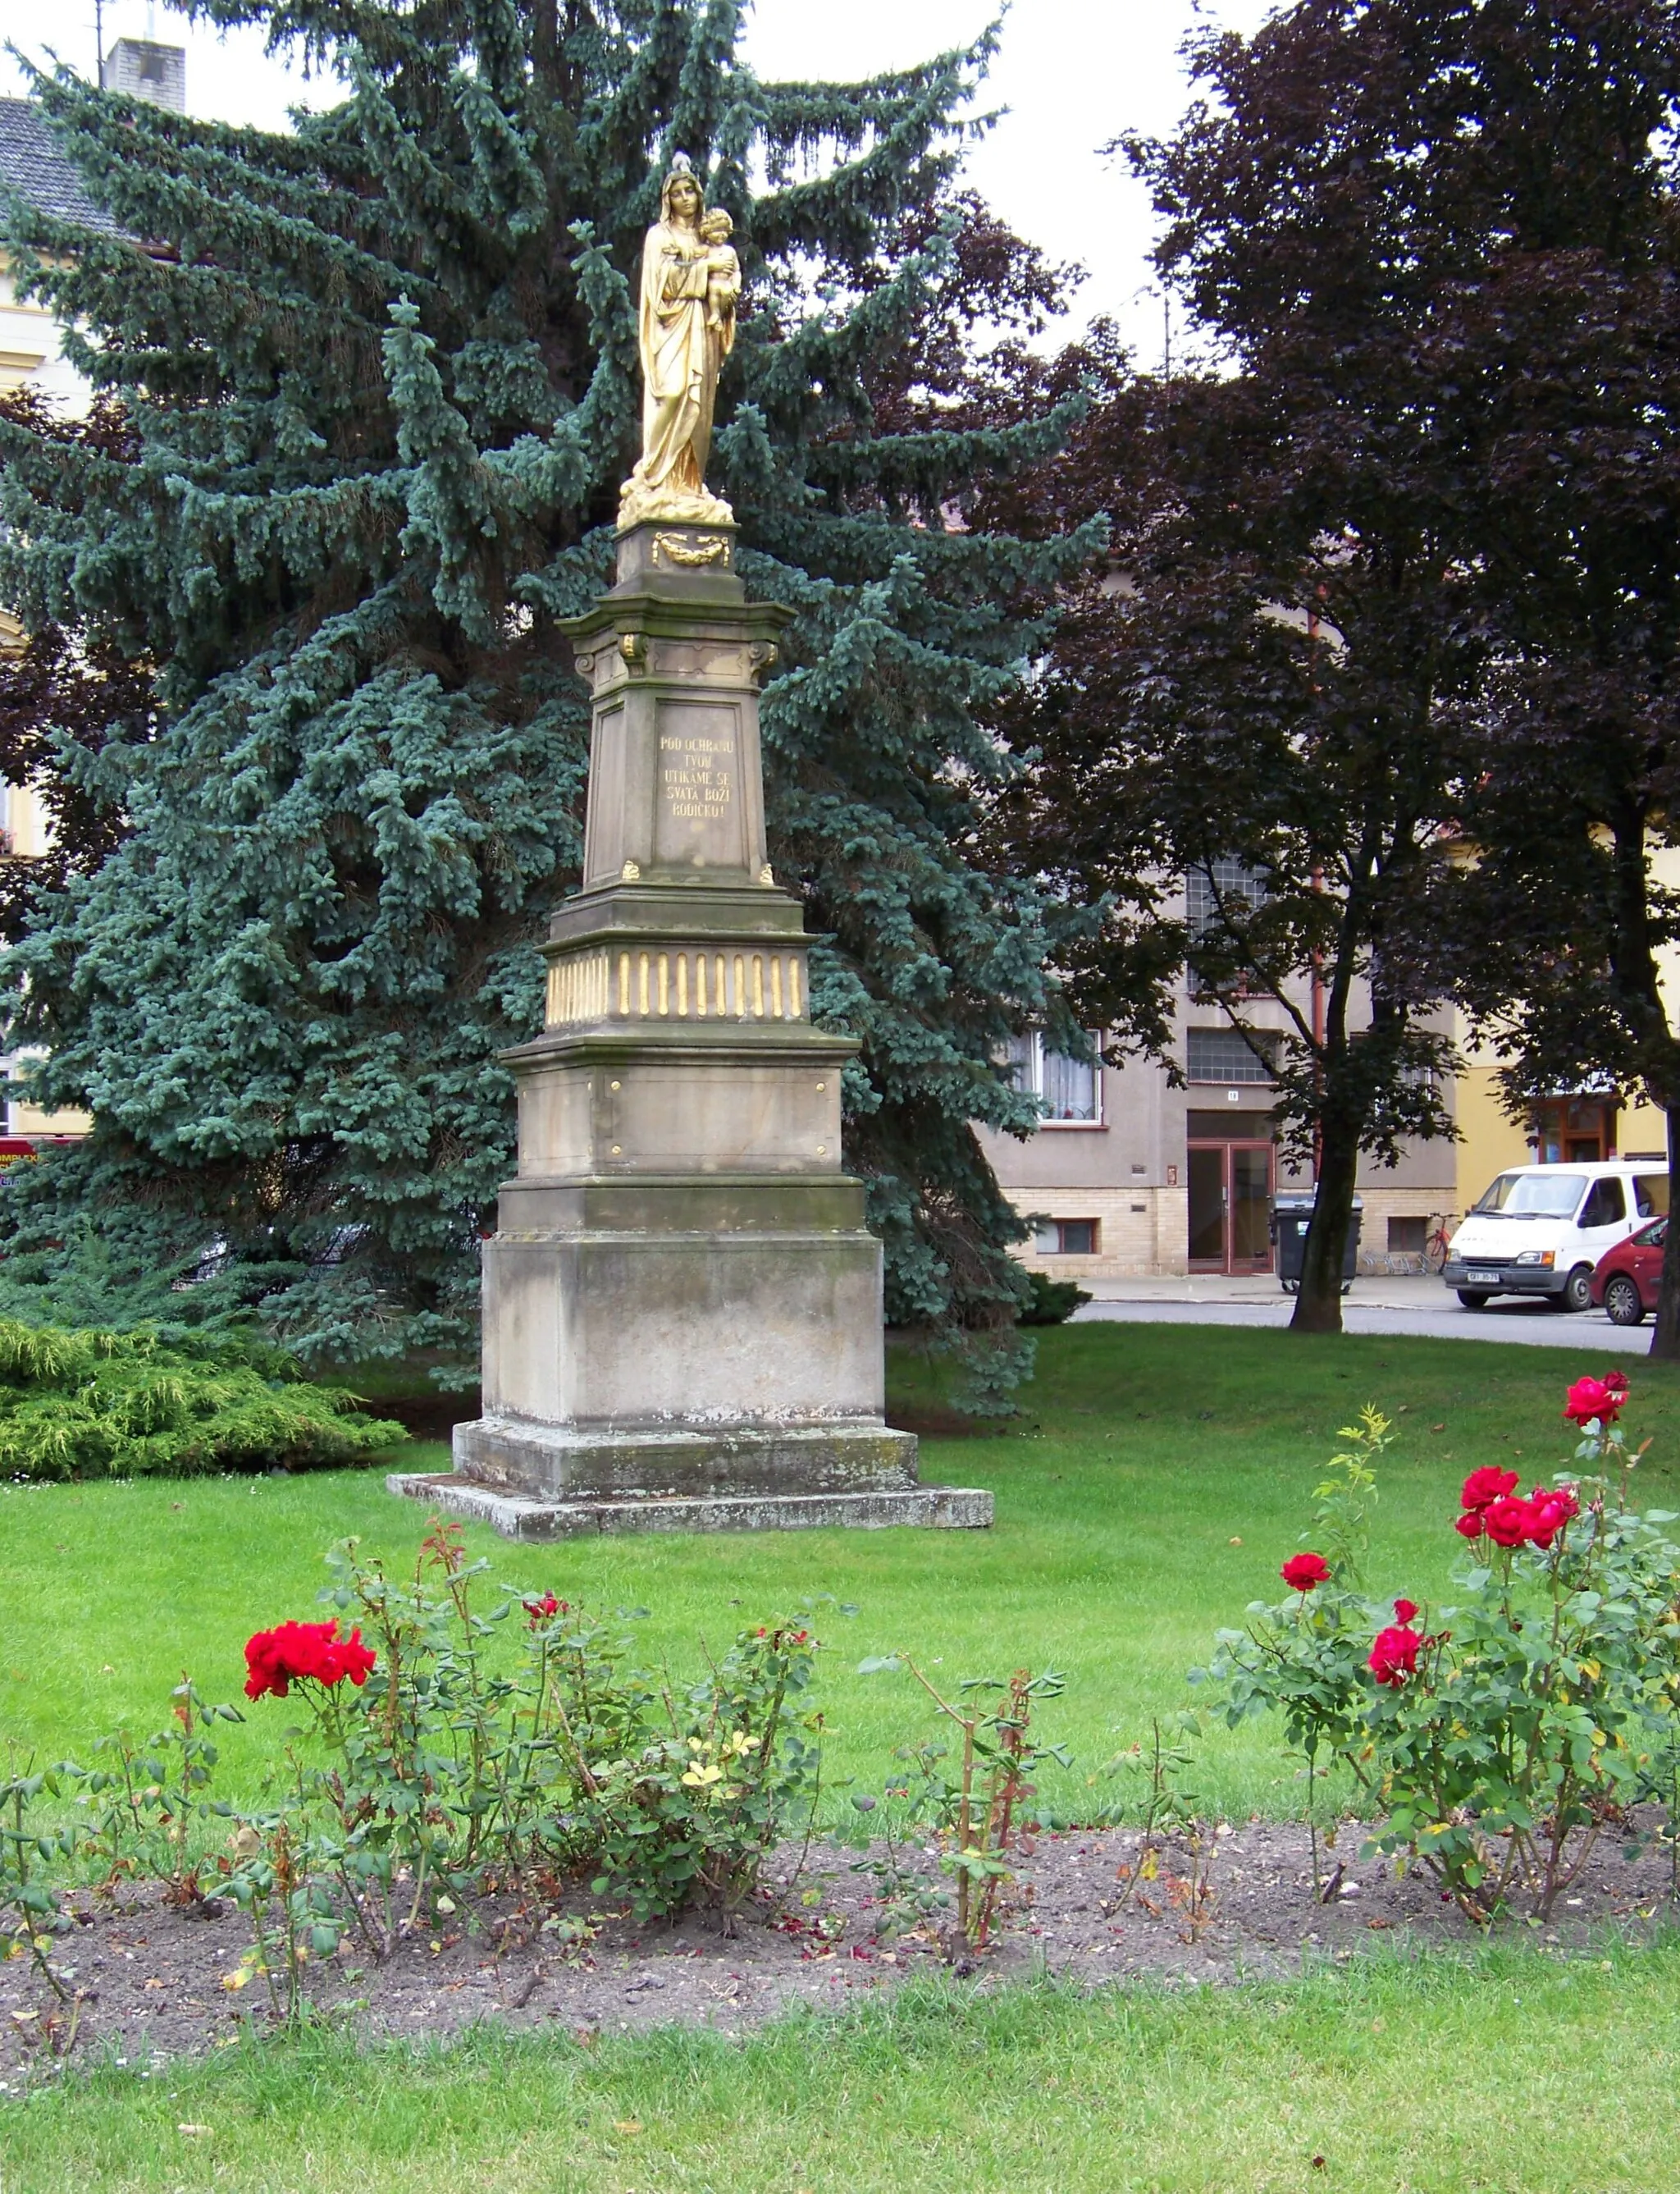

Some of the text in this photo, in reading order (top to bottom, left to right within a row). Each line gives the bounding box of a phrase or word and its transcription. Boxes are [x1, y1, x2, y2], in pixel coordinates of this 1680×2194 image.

[660, 737, 682, 751] POD
[667, 784, 699, 800] SVATÁ
[673, 802, 724, 817] RODIČKO!
